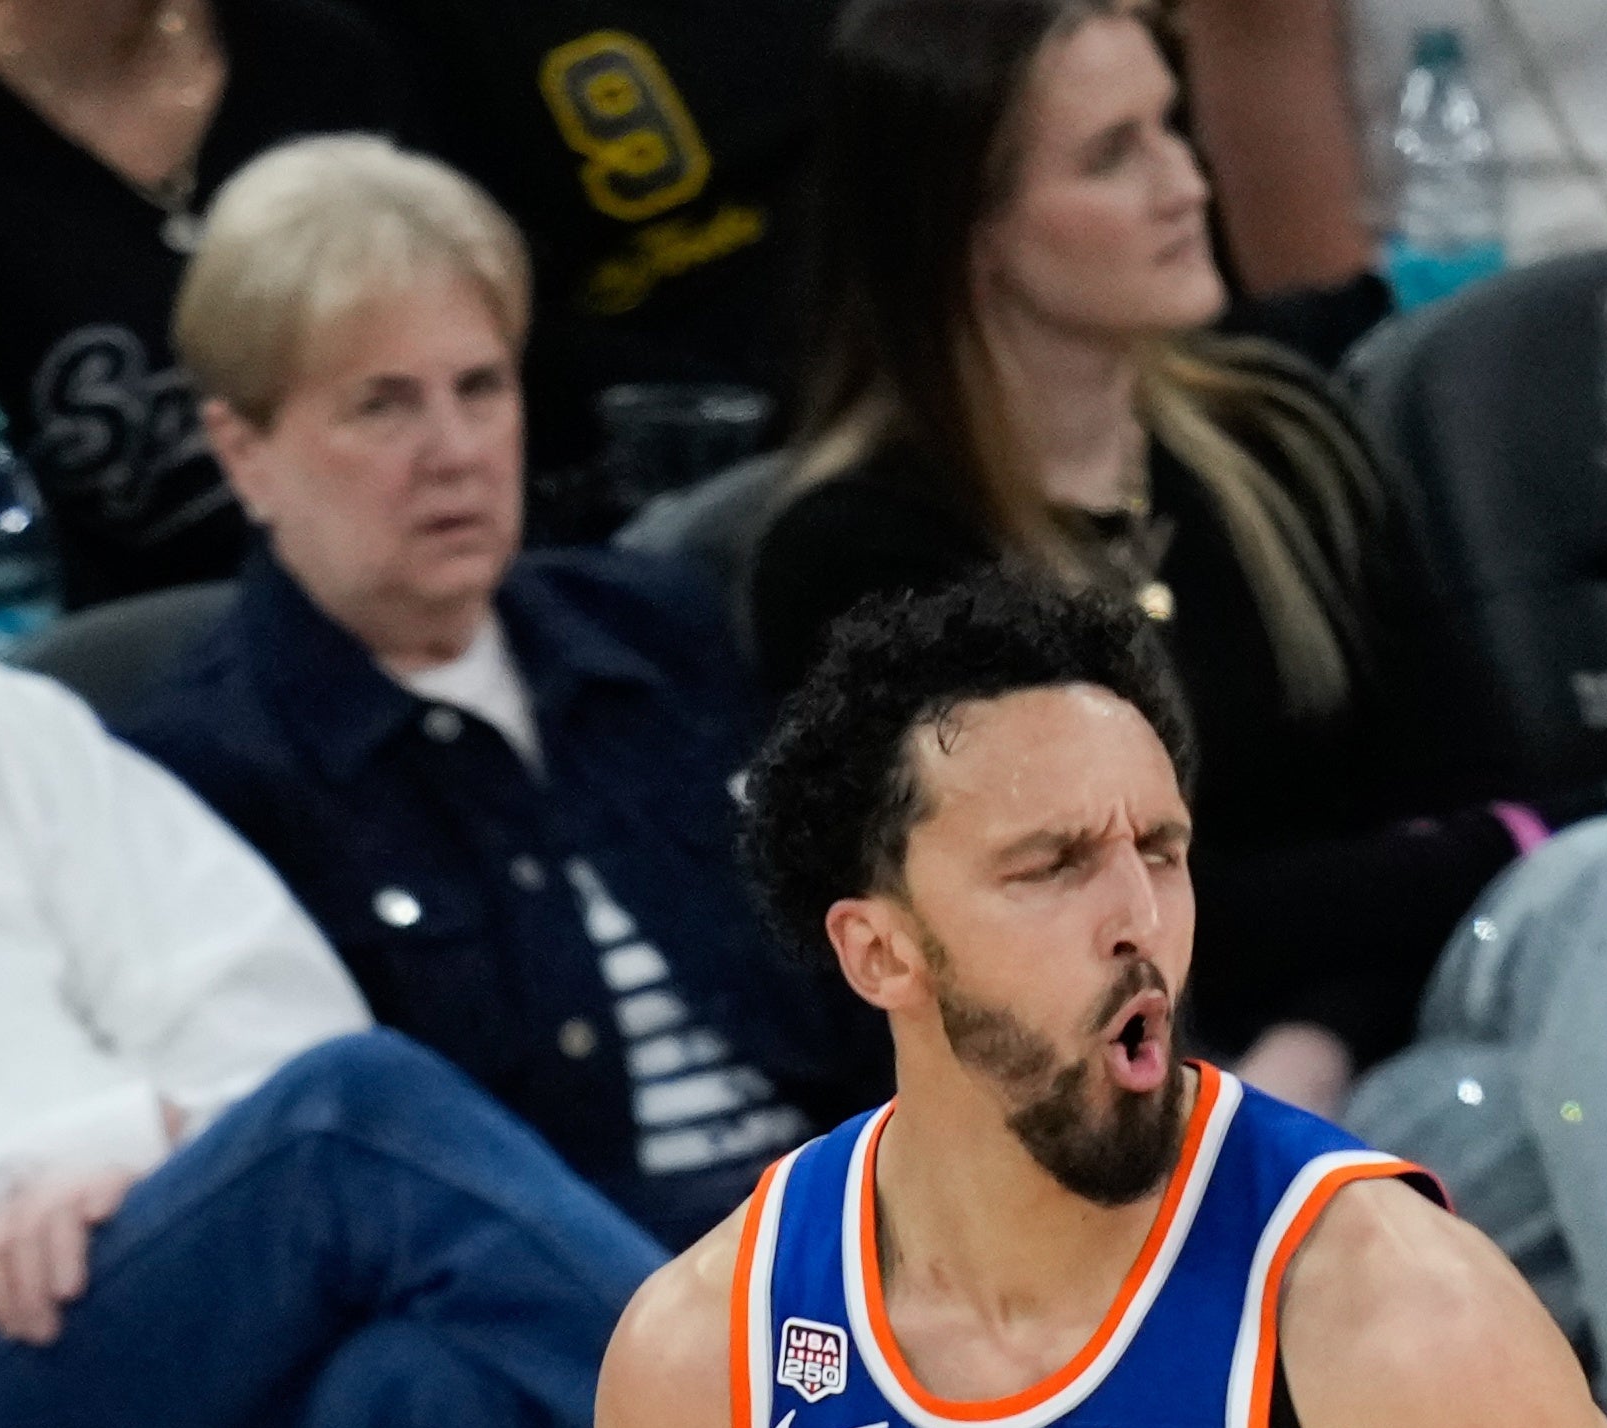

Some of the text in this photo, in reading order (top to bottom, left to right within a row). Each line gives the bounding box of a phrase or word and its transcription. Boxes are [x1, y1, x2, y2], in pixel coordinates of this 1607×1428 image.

[539, 30, 712, 222] 9
[789, 1328, 839, 1355] USA
[783, 1357, 841, 1387] 250
